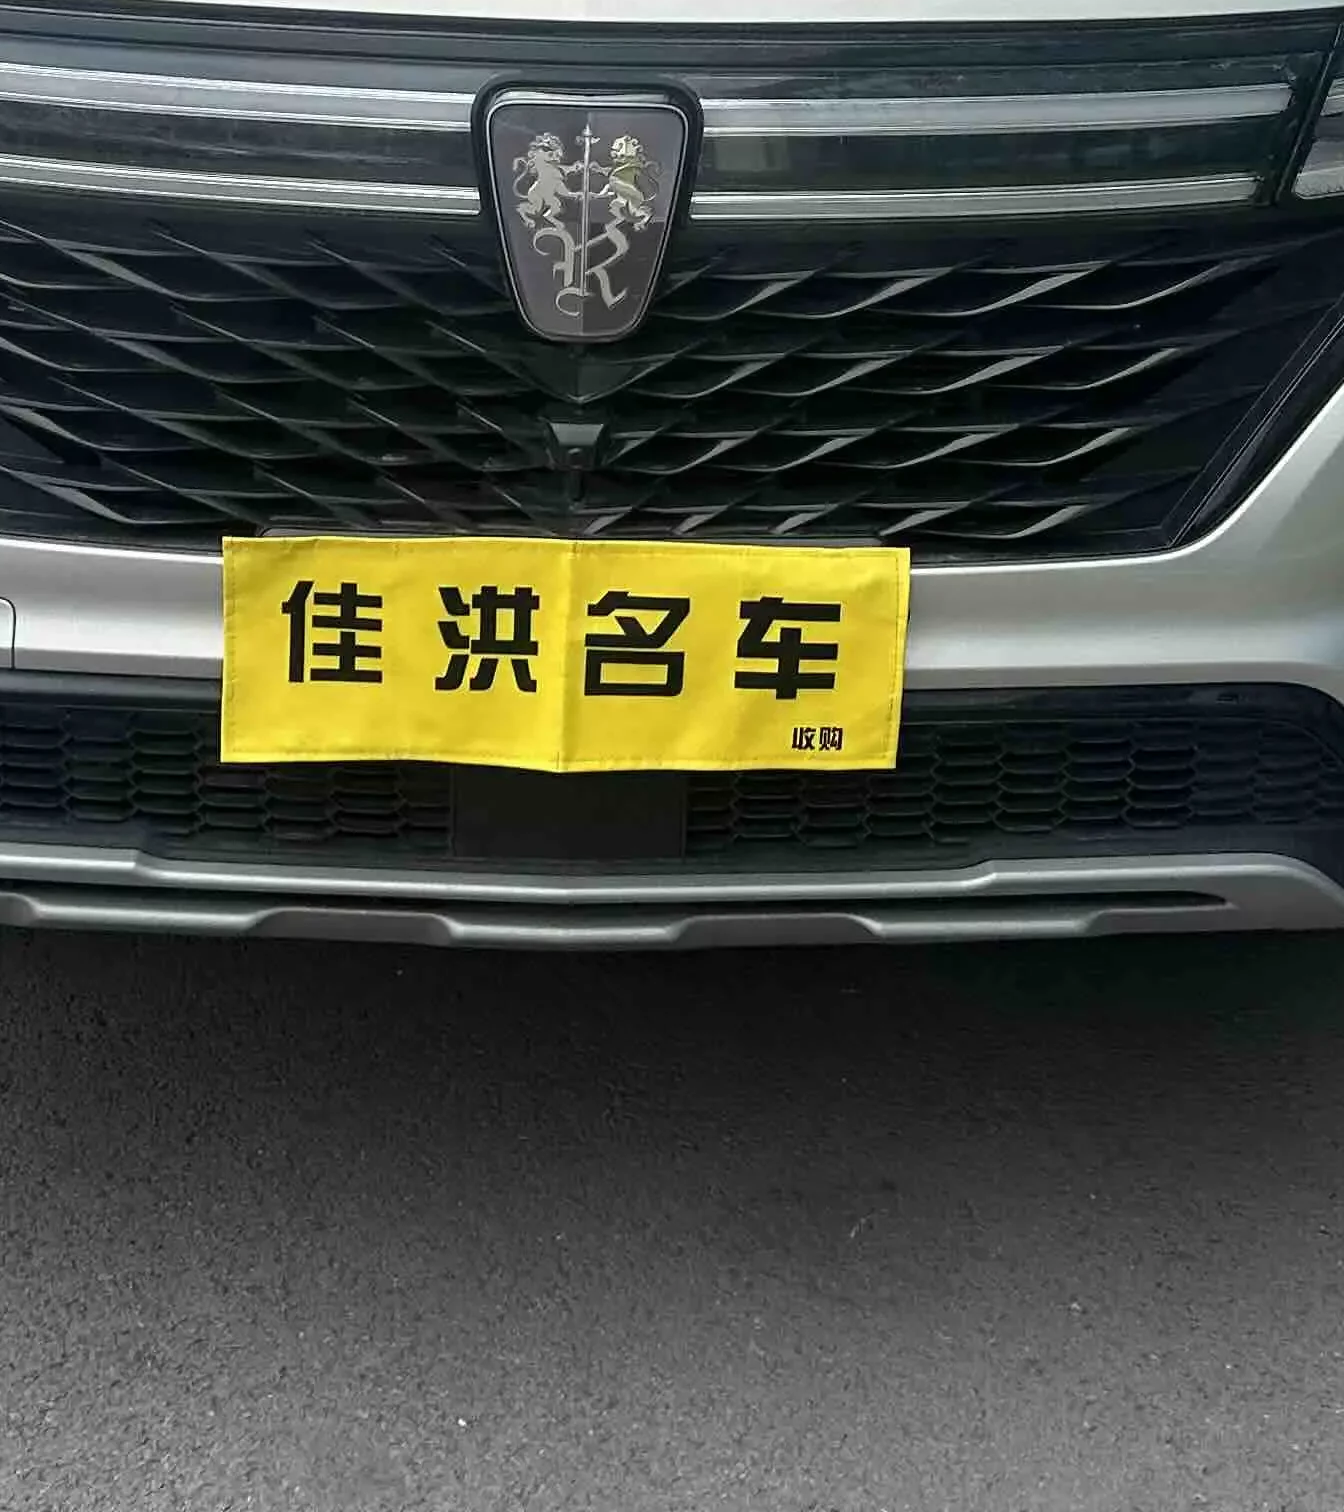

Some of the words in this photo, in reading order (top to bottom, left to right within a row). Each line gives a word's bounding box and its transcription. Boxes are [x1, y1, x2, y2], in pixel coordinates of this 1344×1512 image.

[281, 580, 842, 700] 佳洪名车
[792, 727, 843, 750] 收购
